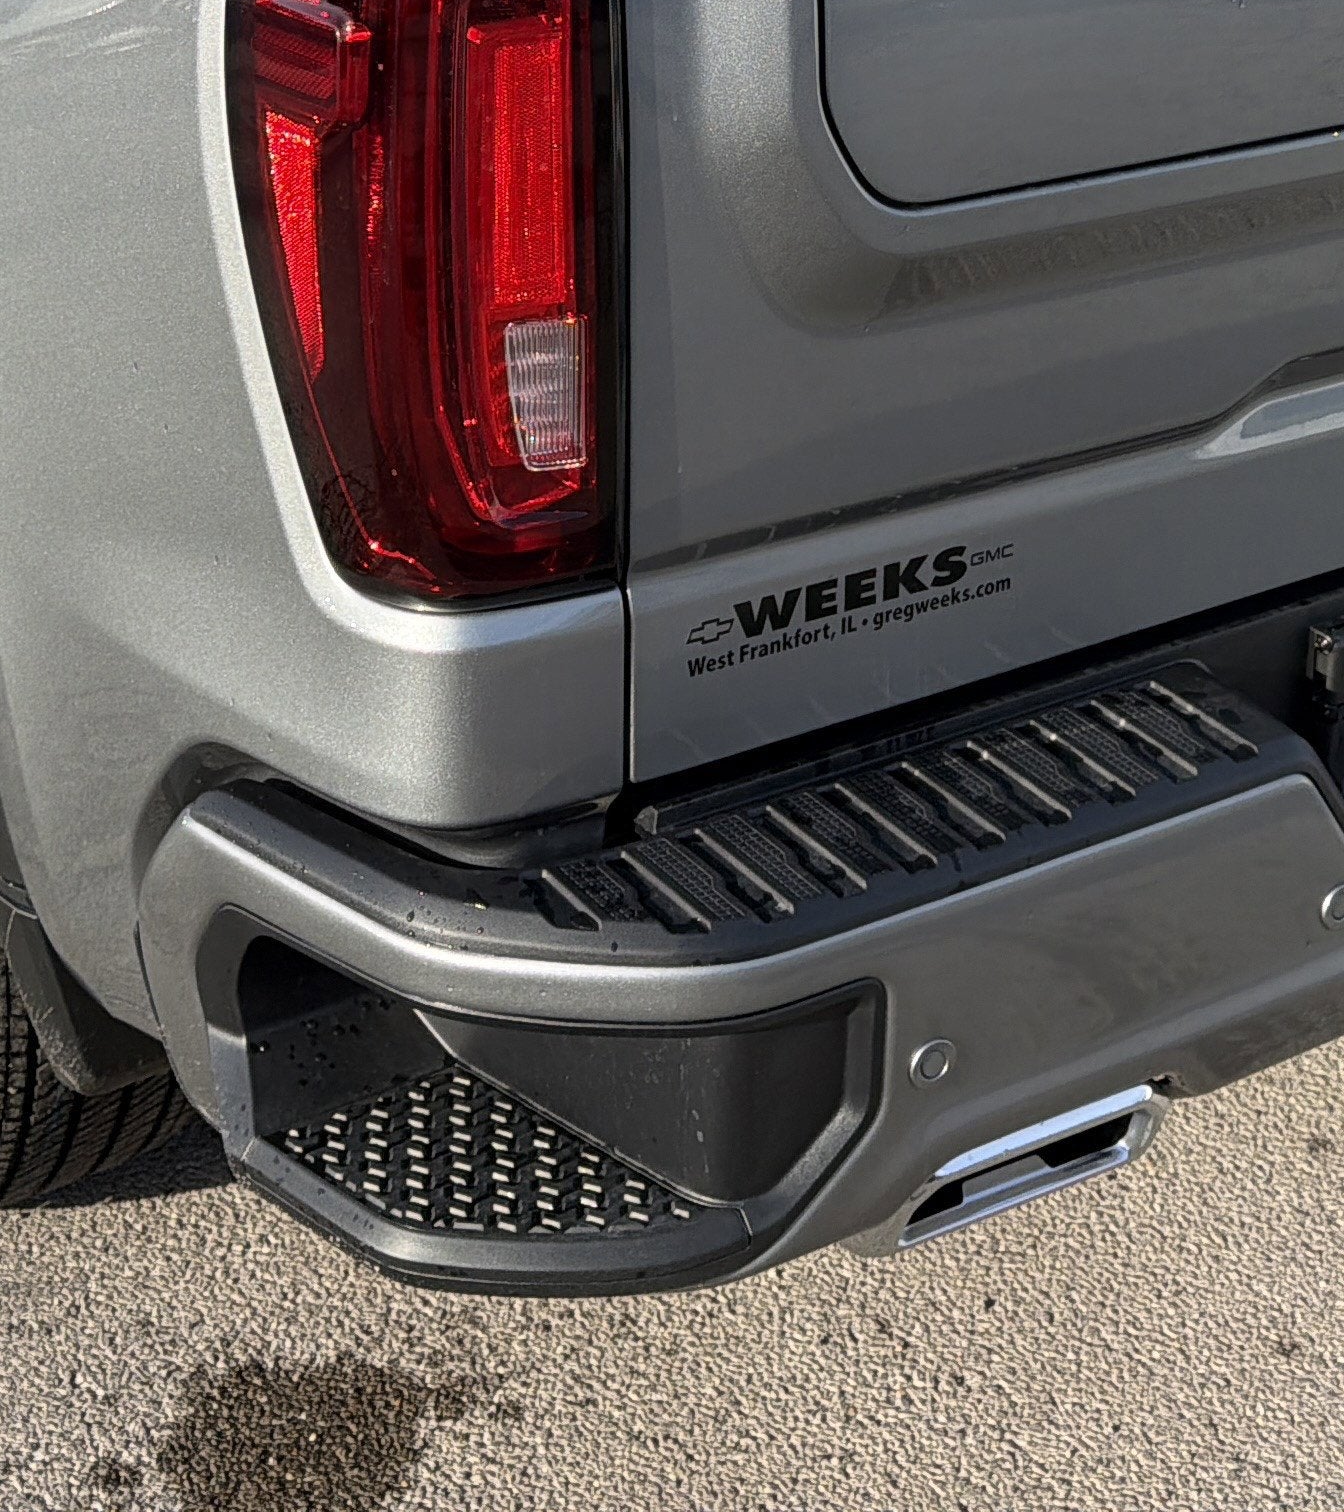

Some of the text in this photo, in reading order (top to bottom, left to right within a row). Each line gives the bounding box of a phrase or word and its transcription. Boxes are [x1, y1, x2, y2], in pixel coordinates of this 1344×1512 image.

[687, 576, 1012, 678] West Frankfort, IL gregweeks.com
[733, 543, 1014, 639] WEEKS GMC
